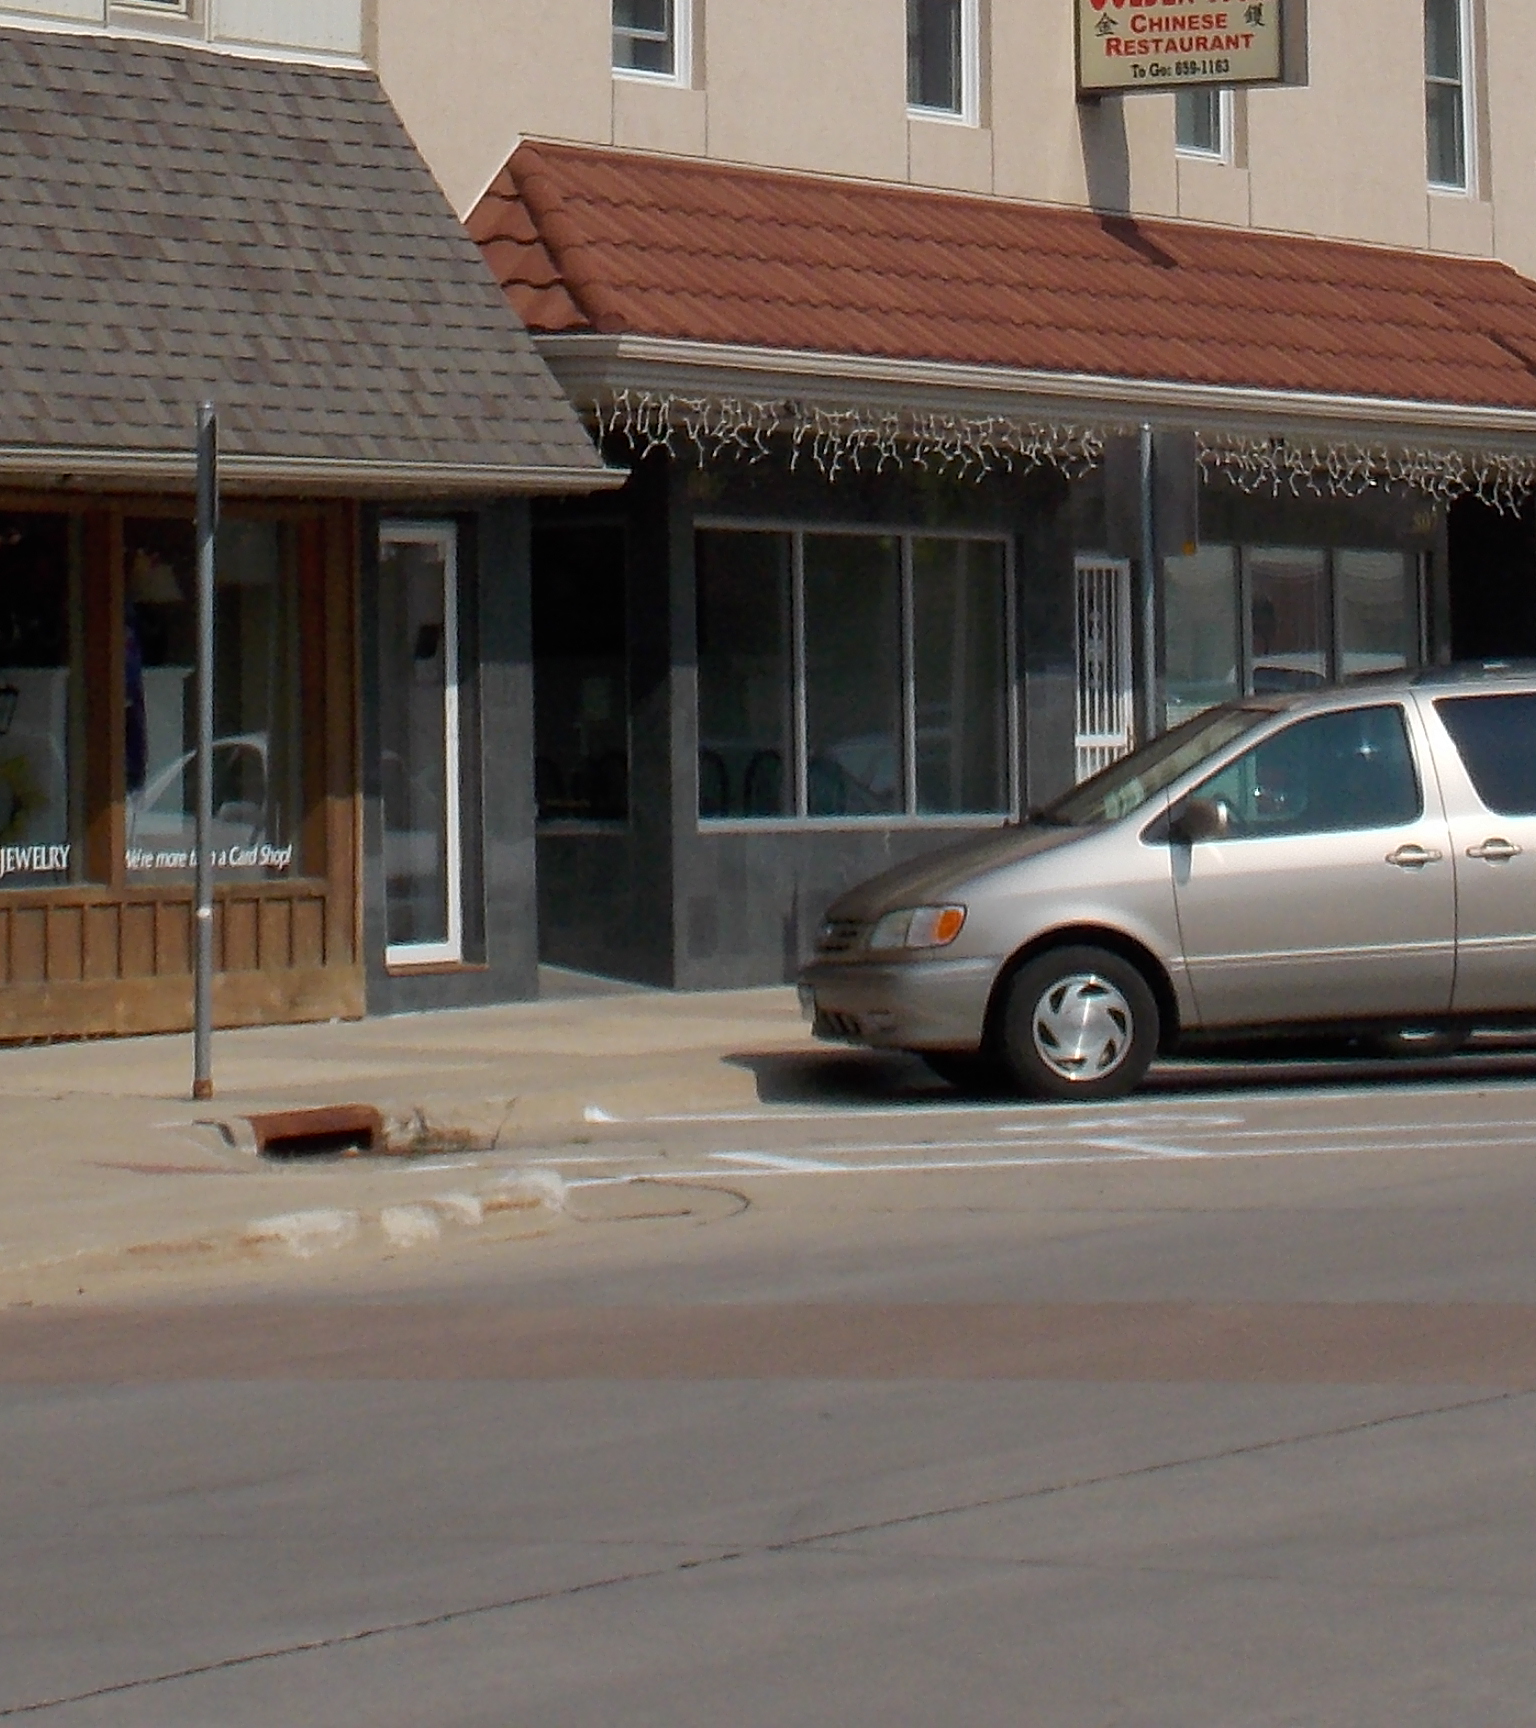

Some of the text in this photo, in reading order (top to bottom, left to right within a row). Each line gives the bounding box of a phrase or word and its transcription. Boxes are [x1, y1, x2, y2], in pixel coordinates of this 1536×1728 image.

[1130, 13, 1227, 34] CHINESE
[1105, 34, 1254, 57] RESTAURANT
[1131, 64, 1146, 78] To
[0, 844, 71, 879] JEWELRY
[155, 850, 187, 869] more
[217, 850, 227, 867] a
[228, 843, 258, 867] Card
